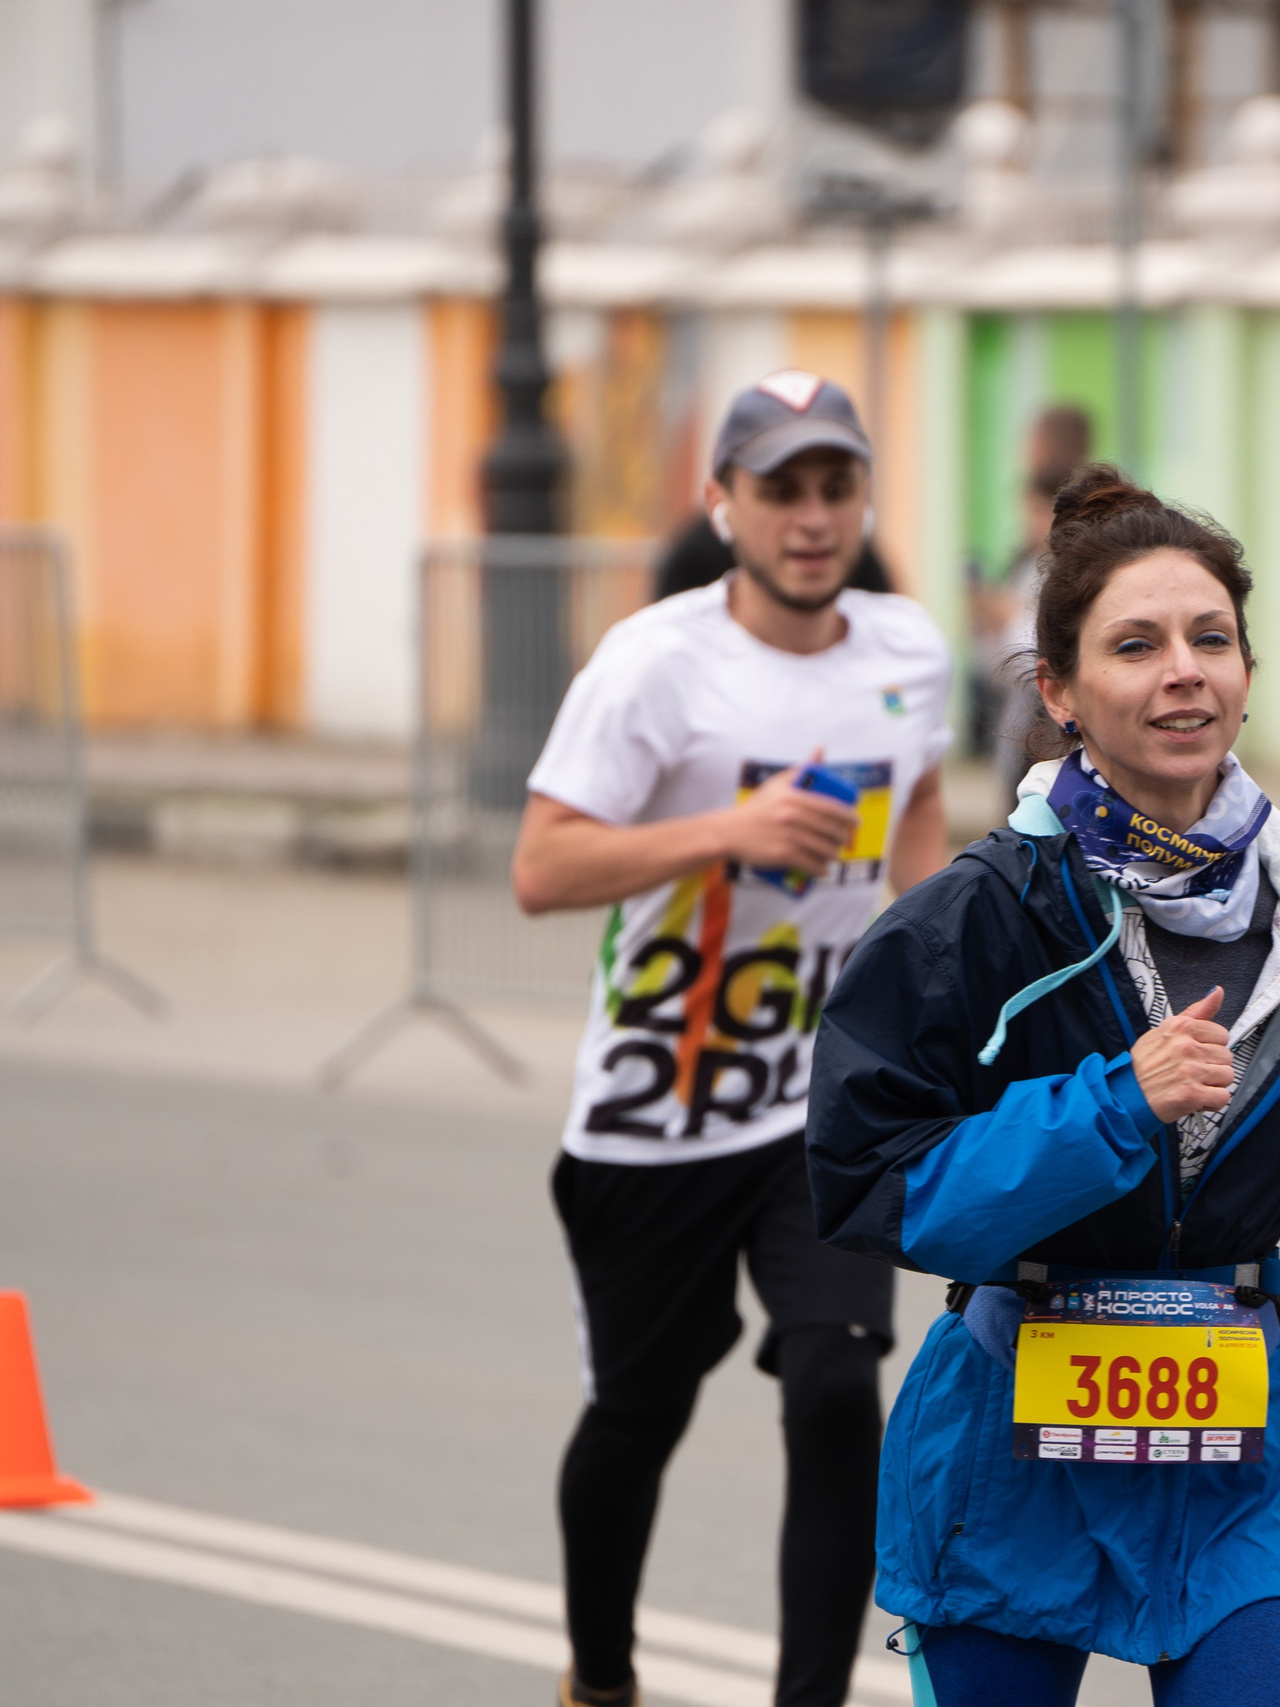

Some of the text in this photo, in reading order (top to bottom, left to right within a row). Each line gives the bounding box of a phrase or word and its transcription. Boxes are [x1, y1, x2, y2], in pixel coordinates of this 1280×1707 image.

[614, 938, 860, 1042] 2GI
[1097, 1290, 1193, 1302] Я ПРОСТО
[1097, 1303, 1194, 1316] КОСМОС
[1030, 1329, 1038, 1339] 3
[1066, 1355, 1218, 1420] 3688
